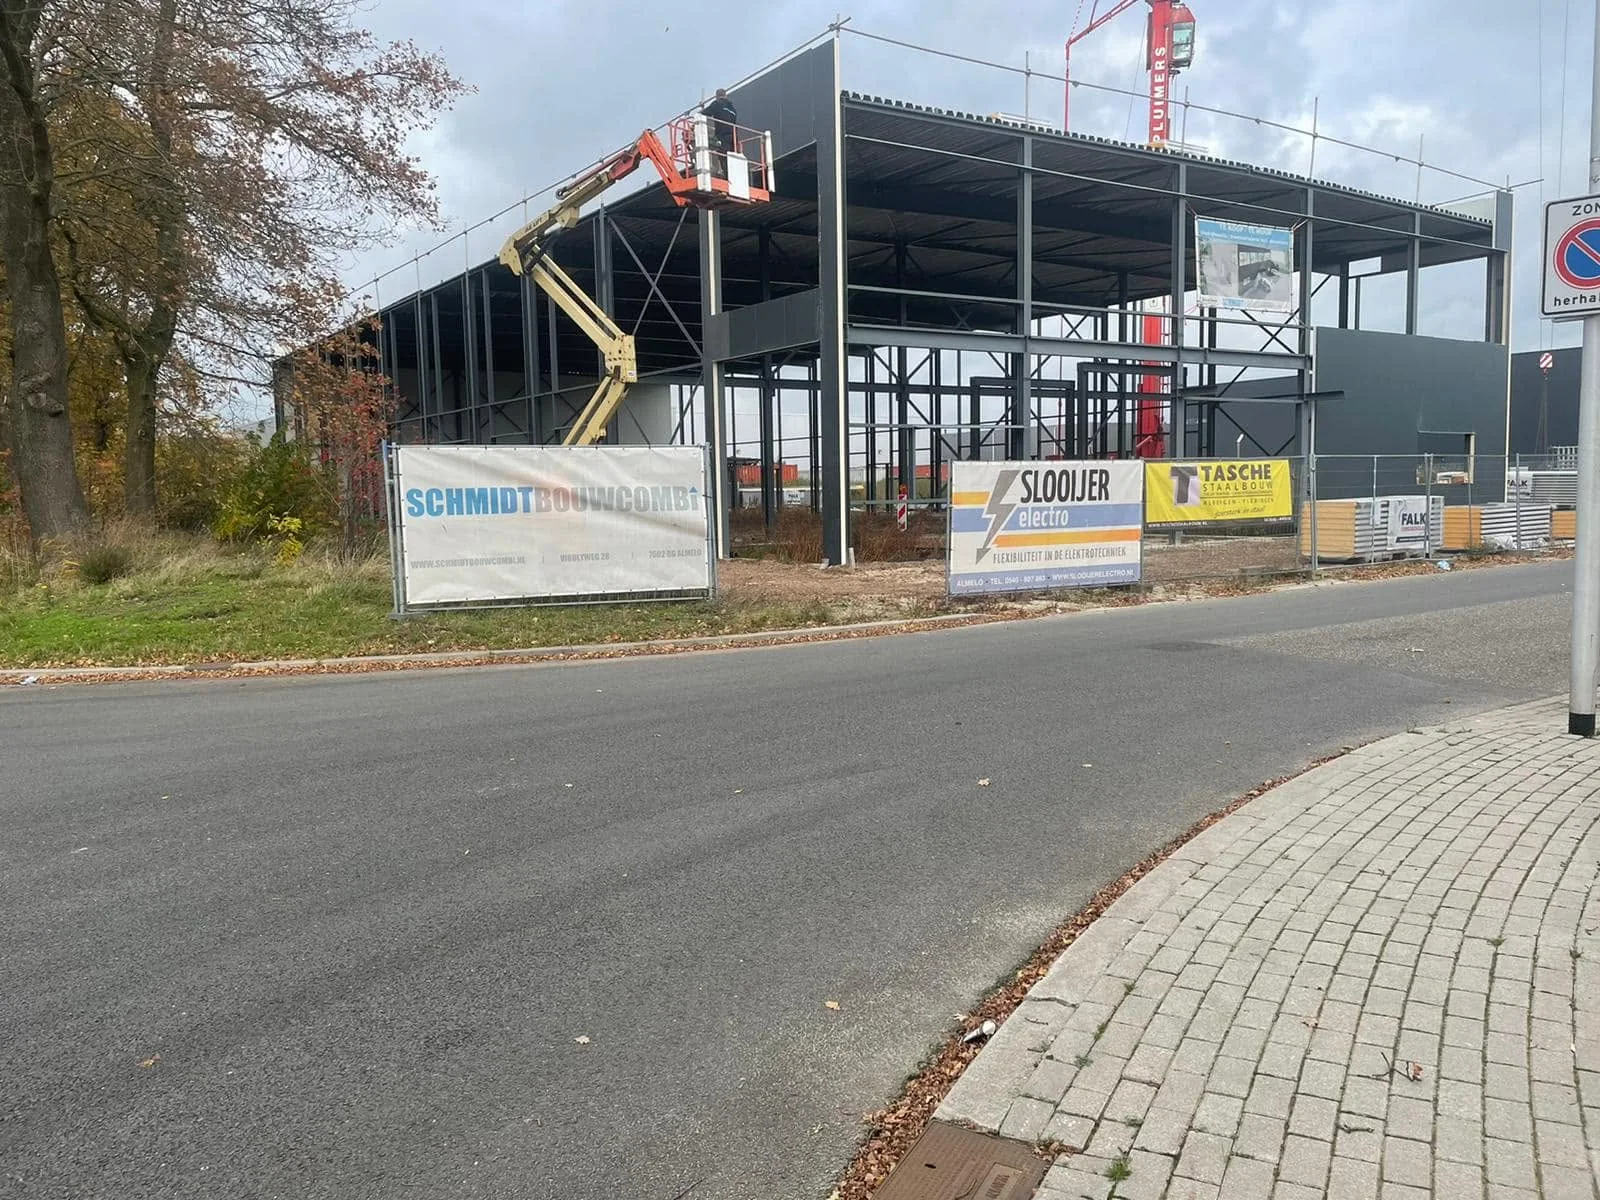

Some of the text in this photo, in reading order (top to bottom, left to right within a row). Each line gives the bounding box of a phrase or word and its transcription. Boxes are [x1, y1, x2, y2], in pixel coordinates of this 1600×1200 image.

[1152, 46, 1166, 143] PLUIMERS
[1201, 464, 1271, 481] TASCHE
[1020, 469, 1110, 503] SLOOIJER
[1203, 481, 1273, 492] STAALBOUW
[1019, 506, 1069, 527] electro
[1401, 512, 1427, 526] FALK
[993, 547, 1126, 563] FLEXIBILITEIT IN DE ELEKTROTECHNIEK
